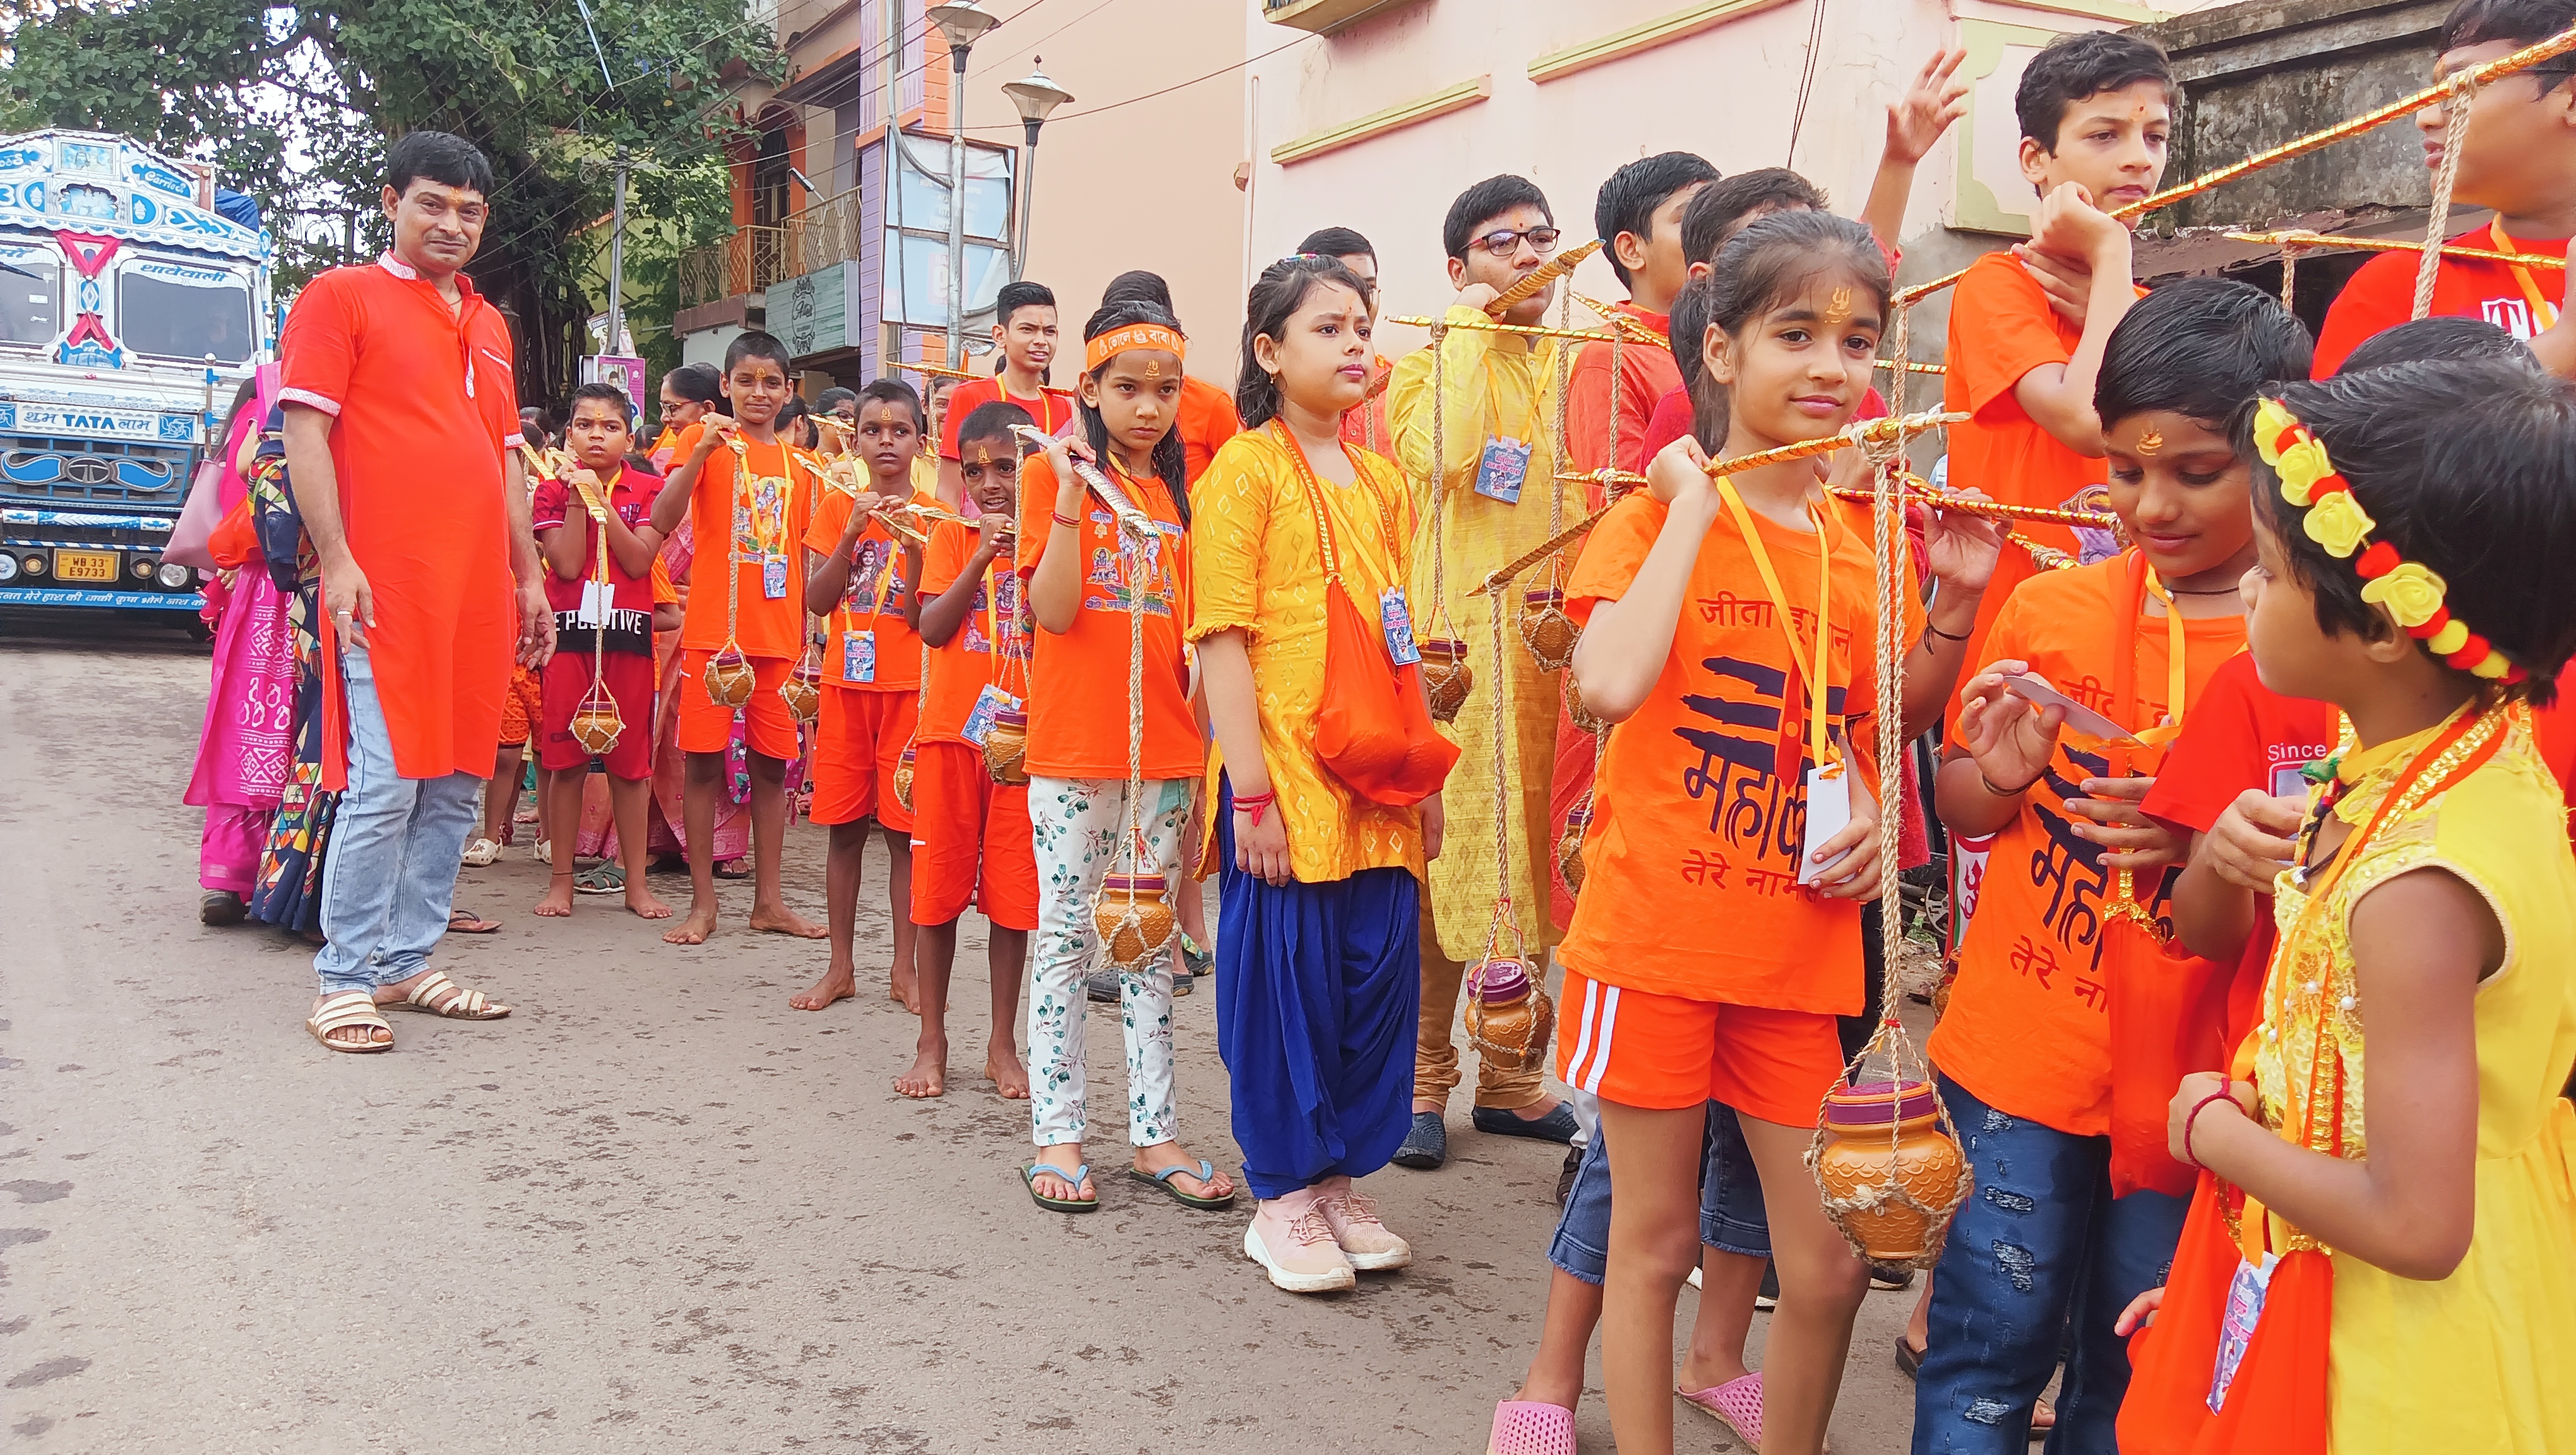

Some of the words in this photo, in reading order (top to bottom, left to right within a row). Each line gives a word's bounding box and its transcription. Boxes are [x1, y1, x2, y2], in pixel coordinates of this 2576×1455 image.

[1108, 331, 1131, 350] ভোলে
[1148, 330, 1172, 346] বাবা
[23, 412, 58, 424] शुभ
[63, 414, 115, 429] TATA
[118, 418, 152, 431] लाभ
[69, 567, 105, 577] E9733
[73, 557, 86, 567] WB
[91, 558, 104, 568] 33
[24, 590, 42, 601] मेरे
[66, 591, 83, 602] की
[1696, 590, 1776, 628] जीता
[565, 610, 642, 635] PTIVE
[2267, 742, 2327, 761] Since
[1681, 849, 1732, 890] तेरे
[2010, 934, 2061, 991] तेरे
